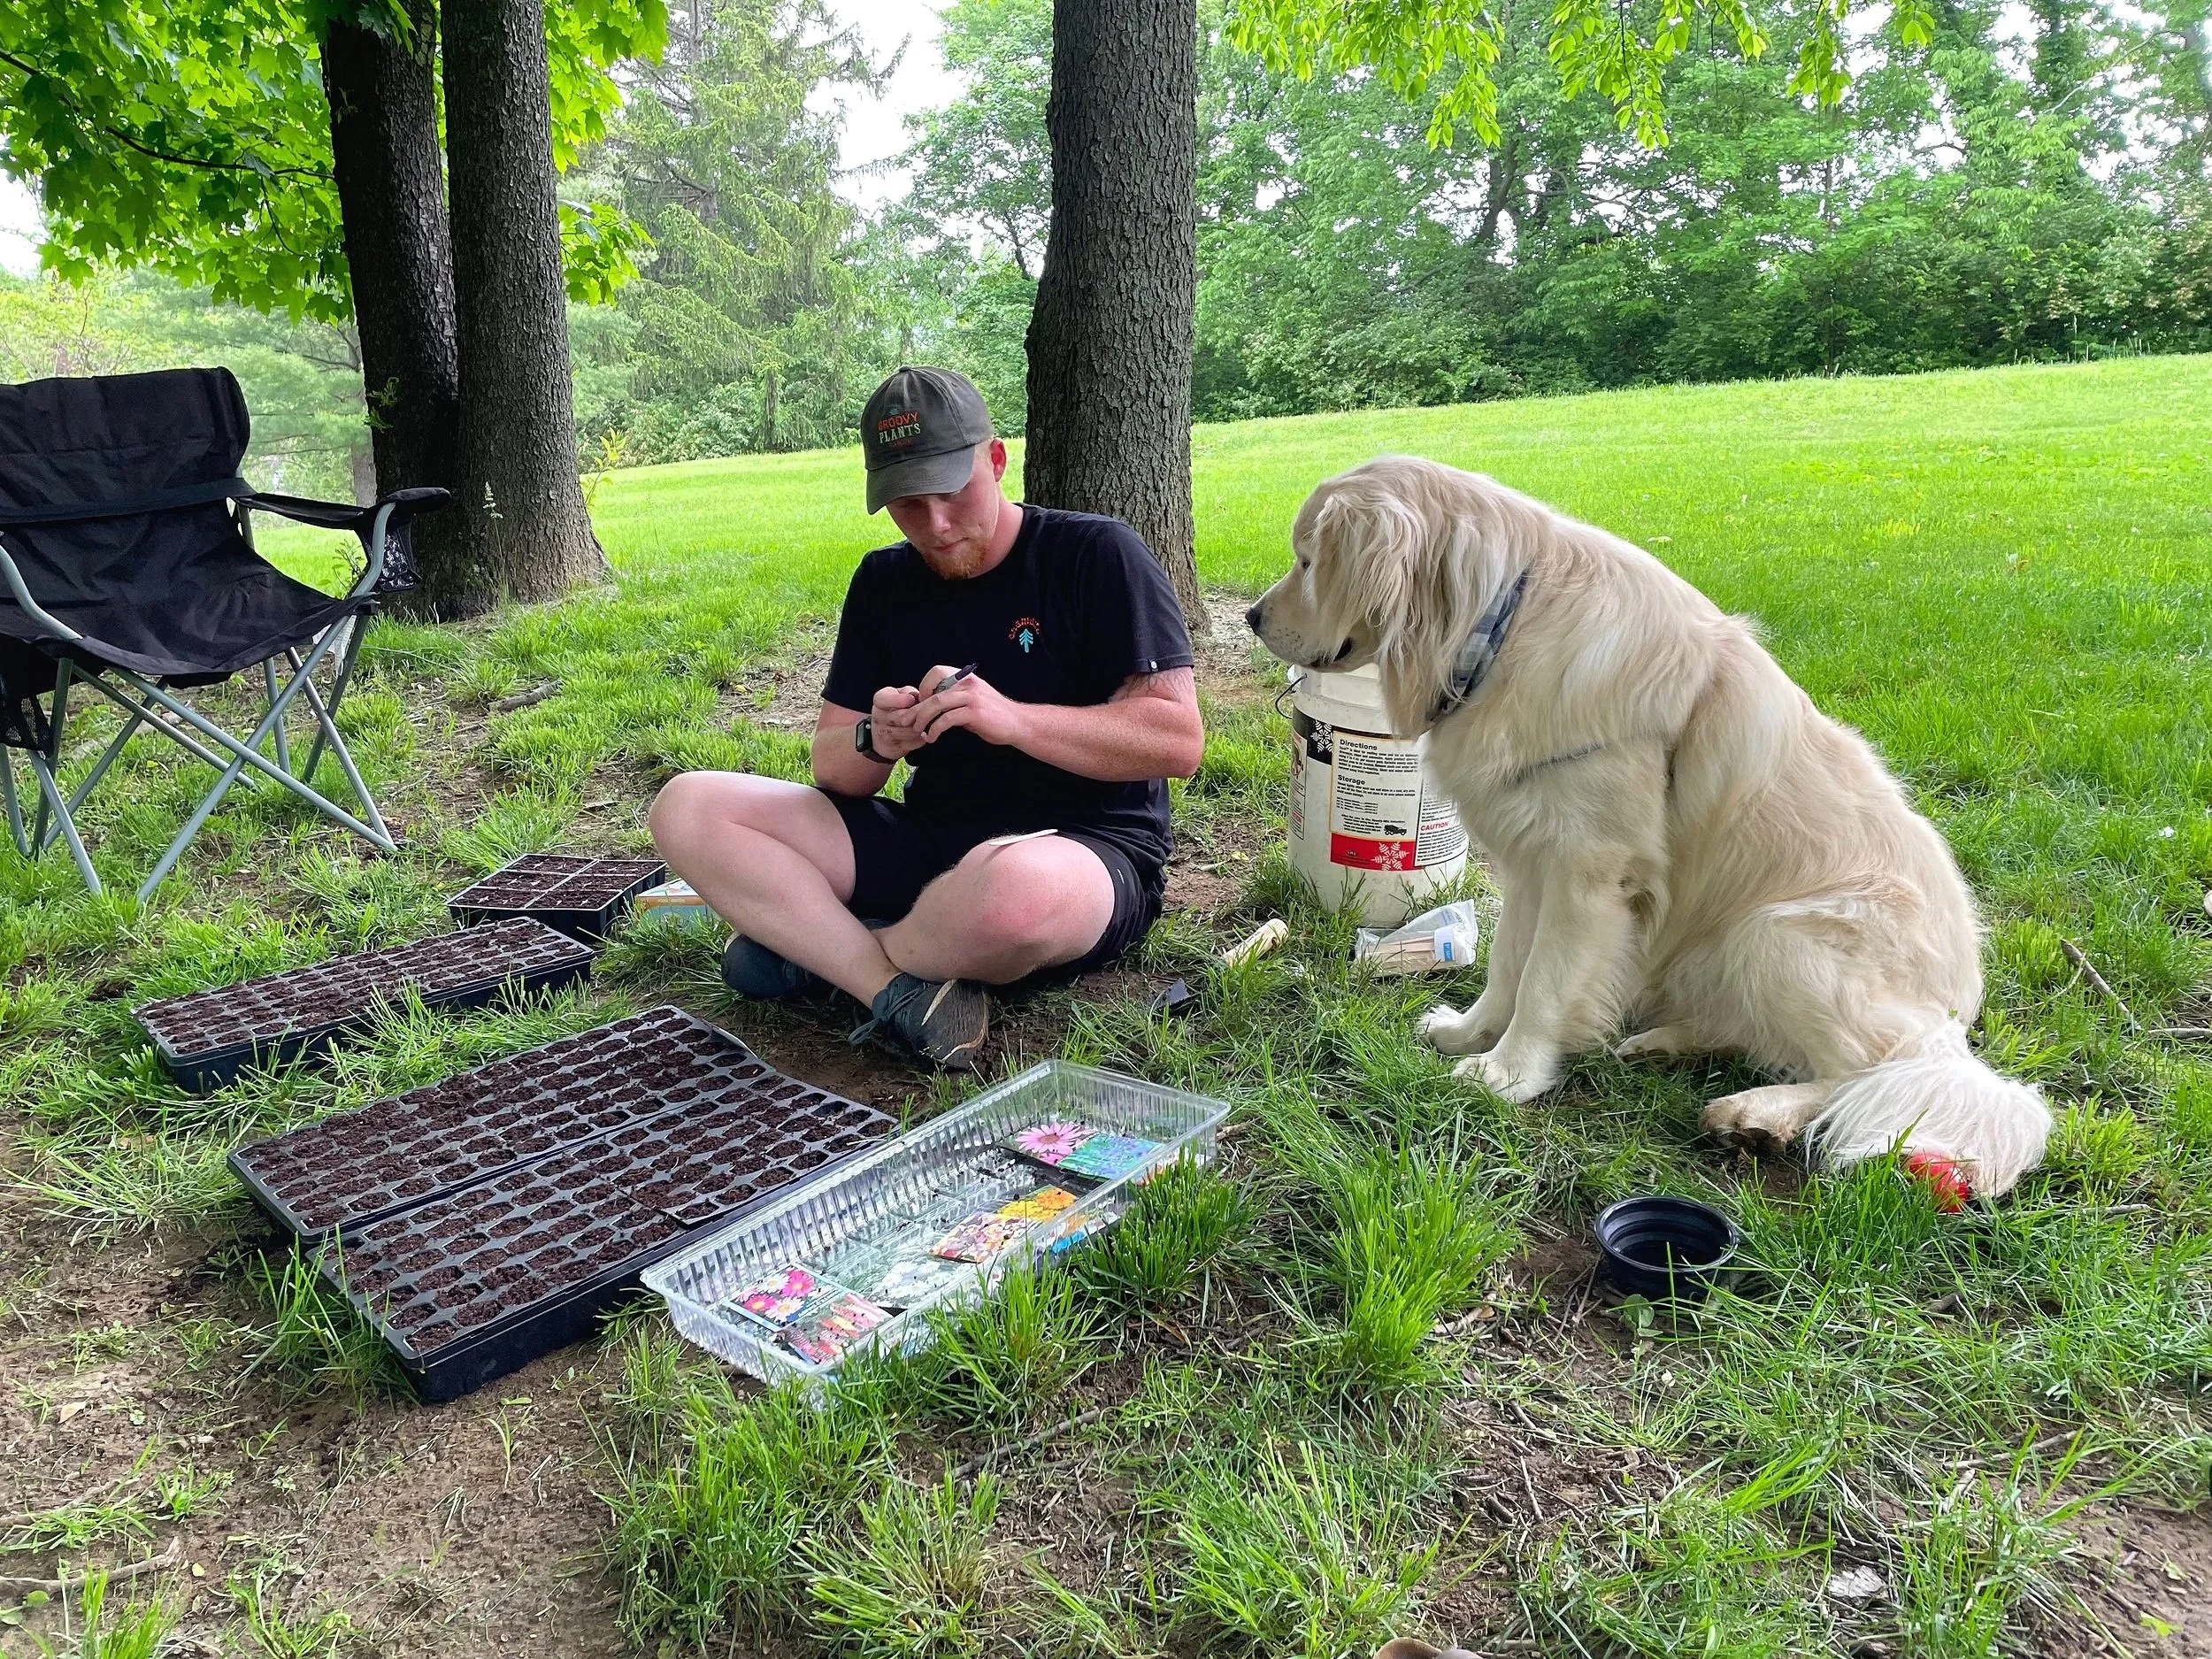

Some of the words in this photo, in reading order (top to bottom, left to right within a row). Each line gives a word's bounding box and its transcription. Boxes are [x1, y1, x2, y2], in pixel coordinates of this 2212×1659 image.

[878, 411, 918, 431] GROOVY
[879, 423, 921, 444] PLANTS
[1340, 739, 1378, 751] Directions
[1337, 774, 1365, 786] Storage
[1420, 821, 1449, 832] CAUTION
